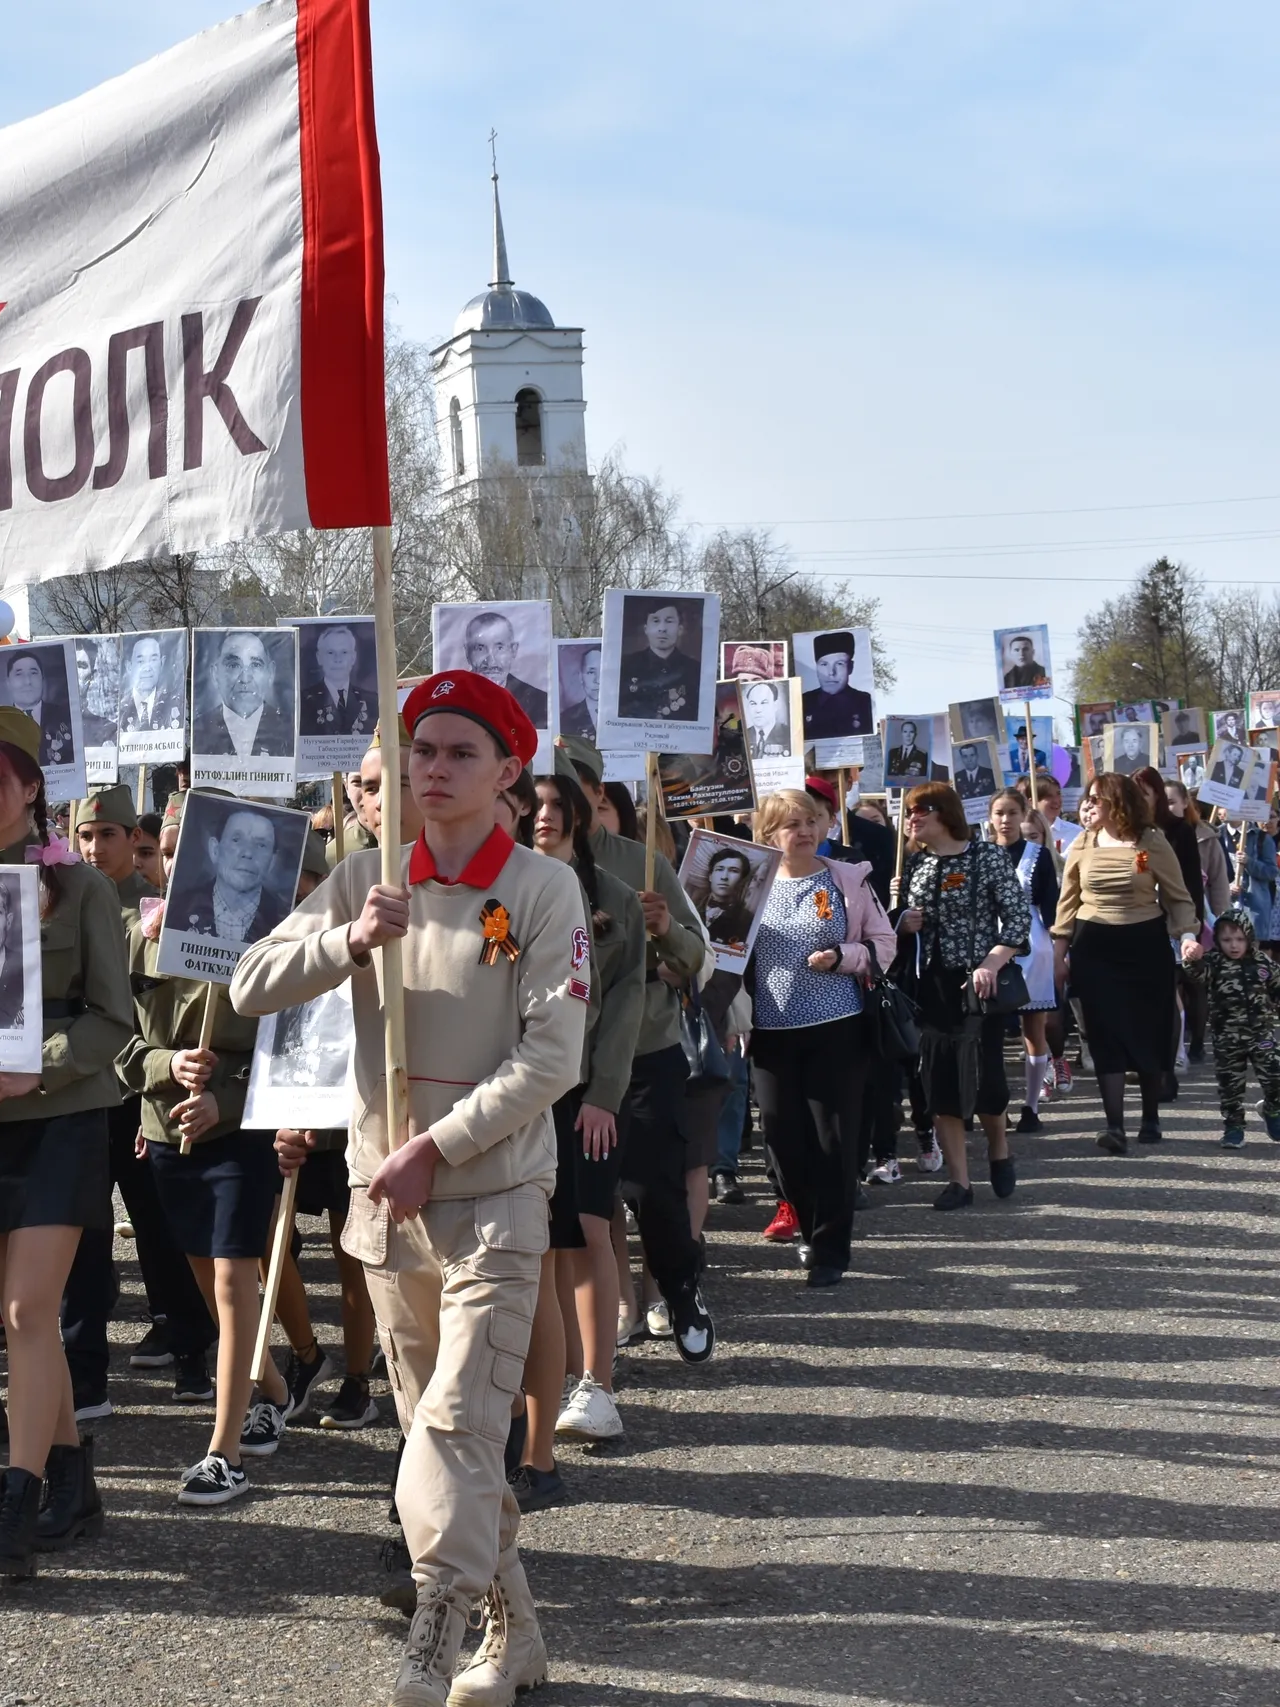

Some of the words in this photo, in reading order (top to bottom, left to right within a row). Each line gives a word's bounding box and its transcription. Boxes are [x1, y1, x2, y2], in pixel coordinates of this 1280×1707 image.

[643, 721, 662, 729] Хасан
[176, 740, 183, 750] С.
[102, 761, 114, 770] Ш.
[194, 770, 248, 781] НУТФУЛЛИН
[249, 772, 285, 782] ГИНИЯТ
[286, 773, 293, 782] Г.
[689, 784, 724, 793] Байгузин
[667, 794, 691, 802] Хаким
[692, 787, 749, 799] Рахматуллович
